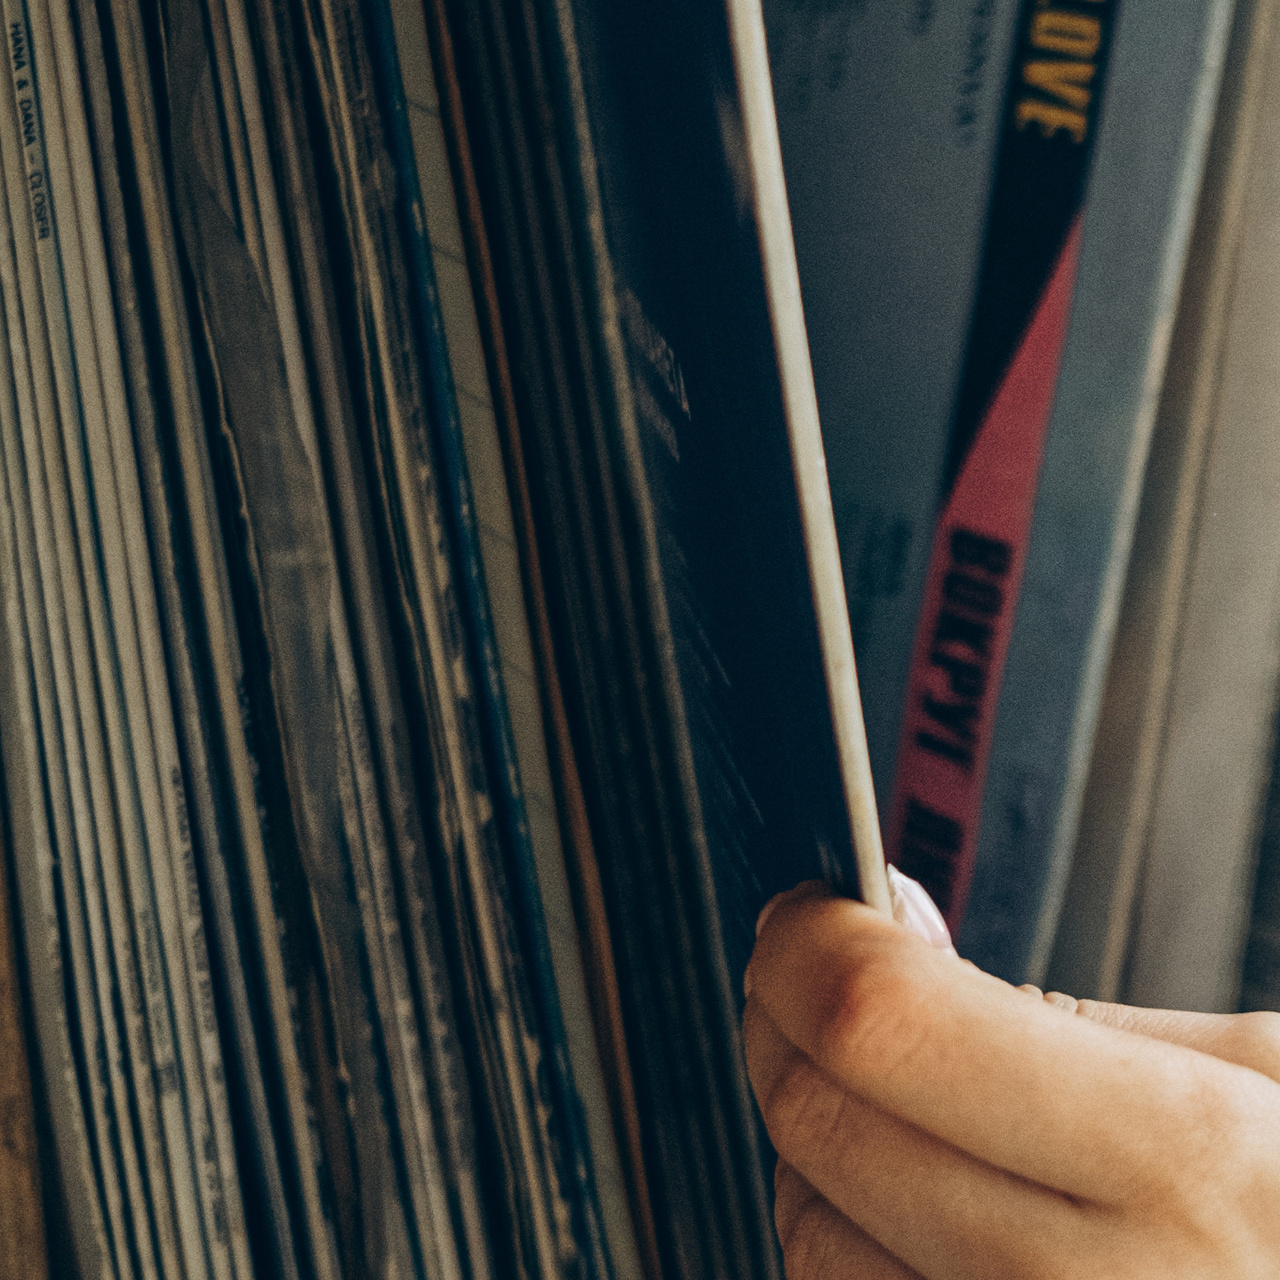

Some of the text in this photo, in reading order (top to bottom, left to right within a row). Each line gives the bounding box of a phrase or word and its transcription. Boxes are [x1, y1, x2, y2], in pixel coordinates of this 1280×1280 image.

[10, 21, 28, 71] HANA
[16, 78, 29, 91] &
[19, 99, 36, 147] DANA
